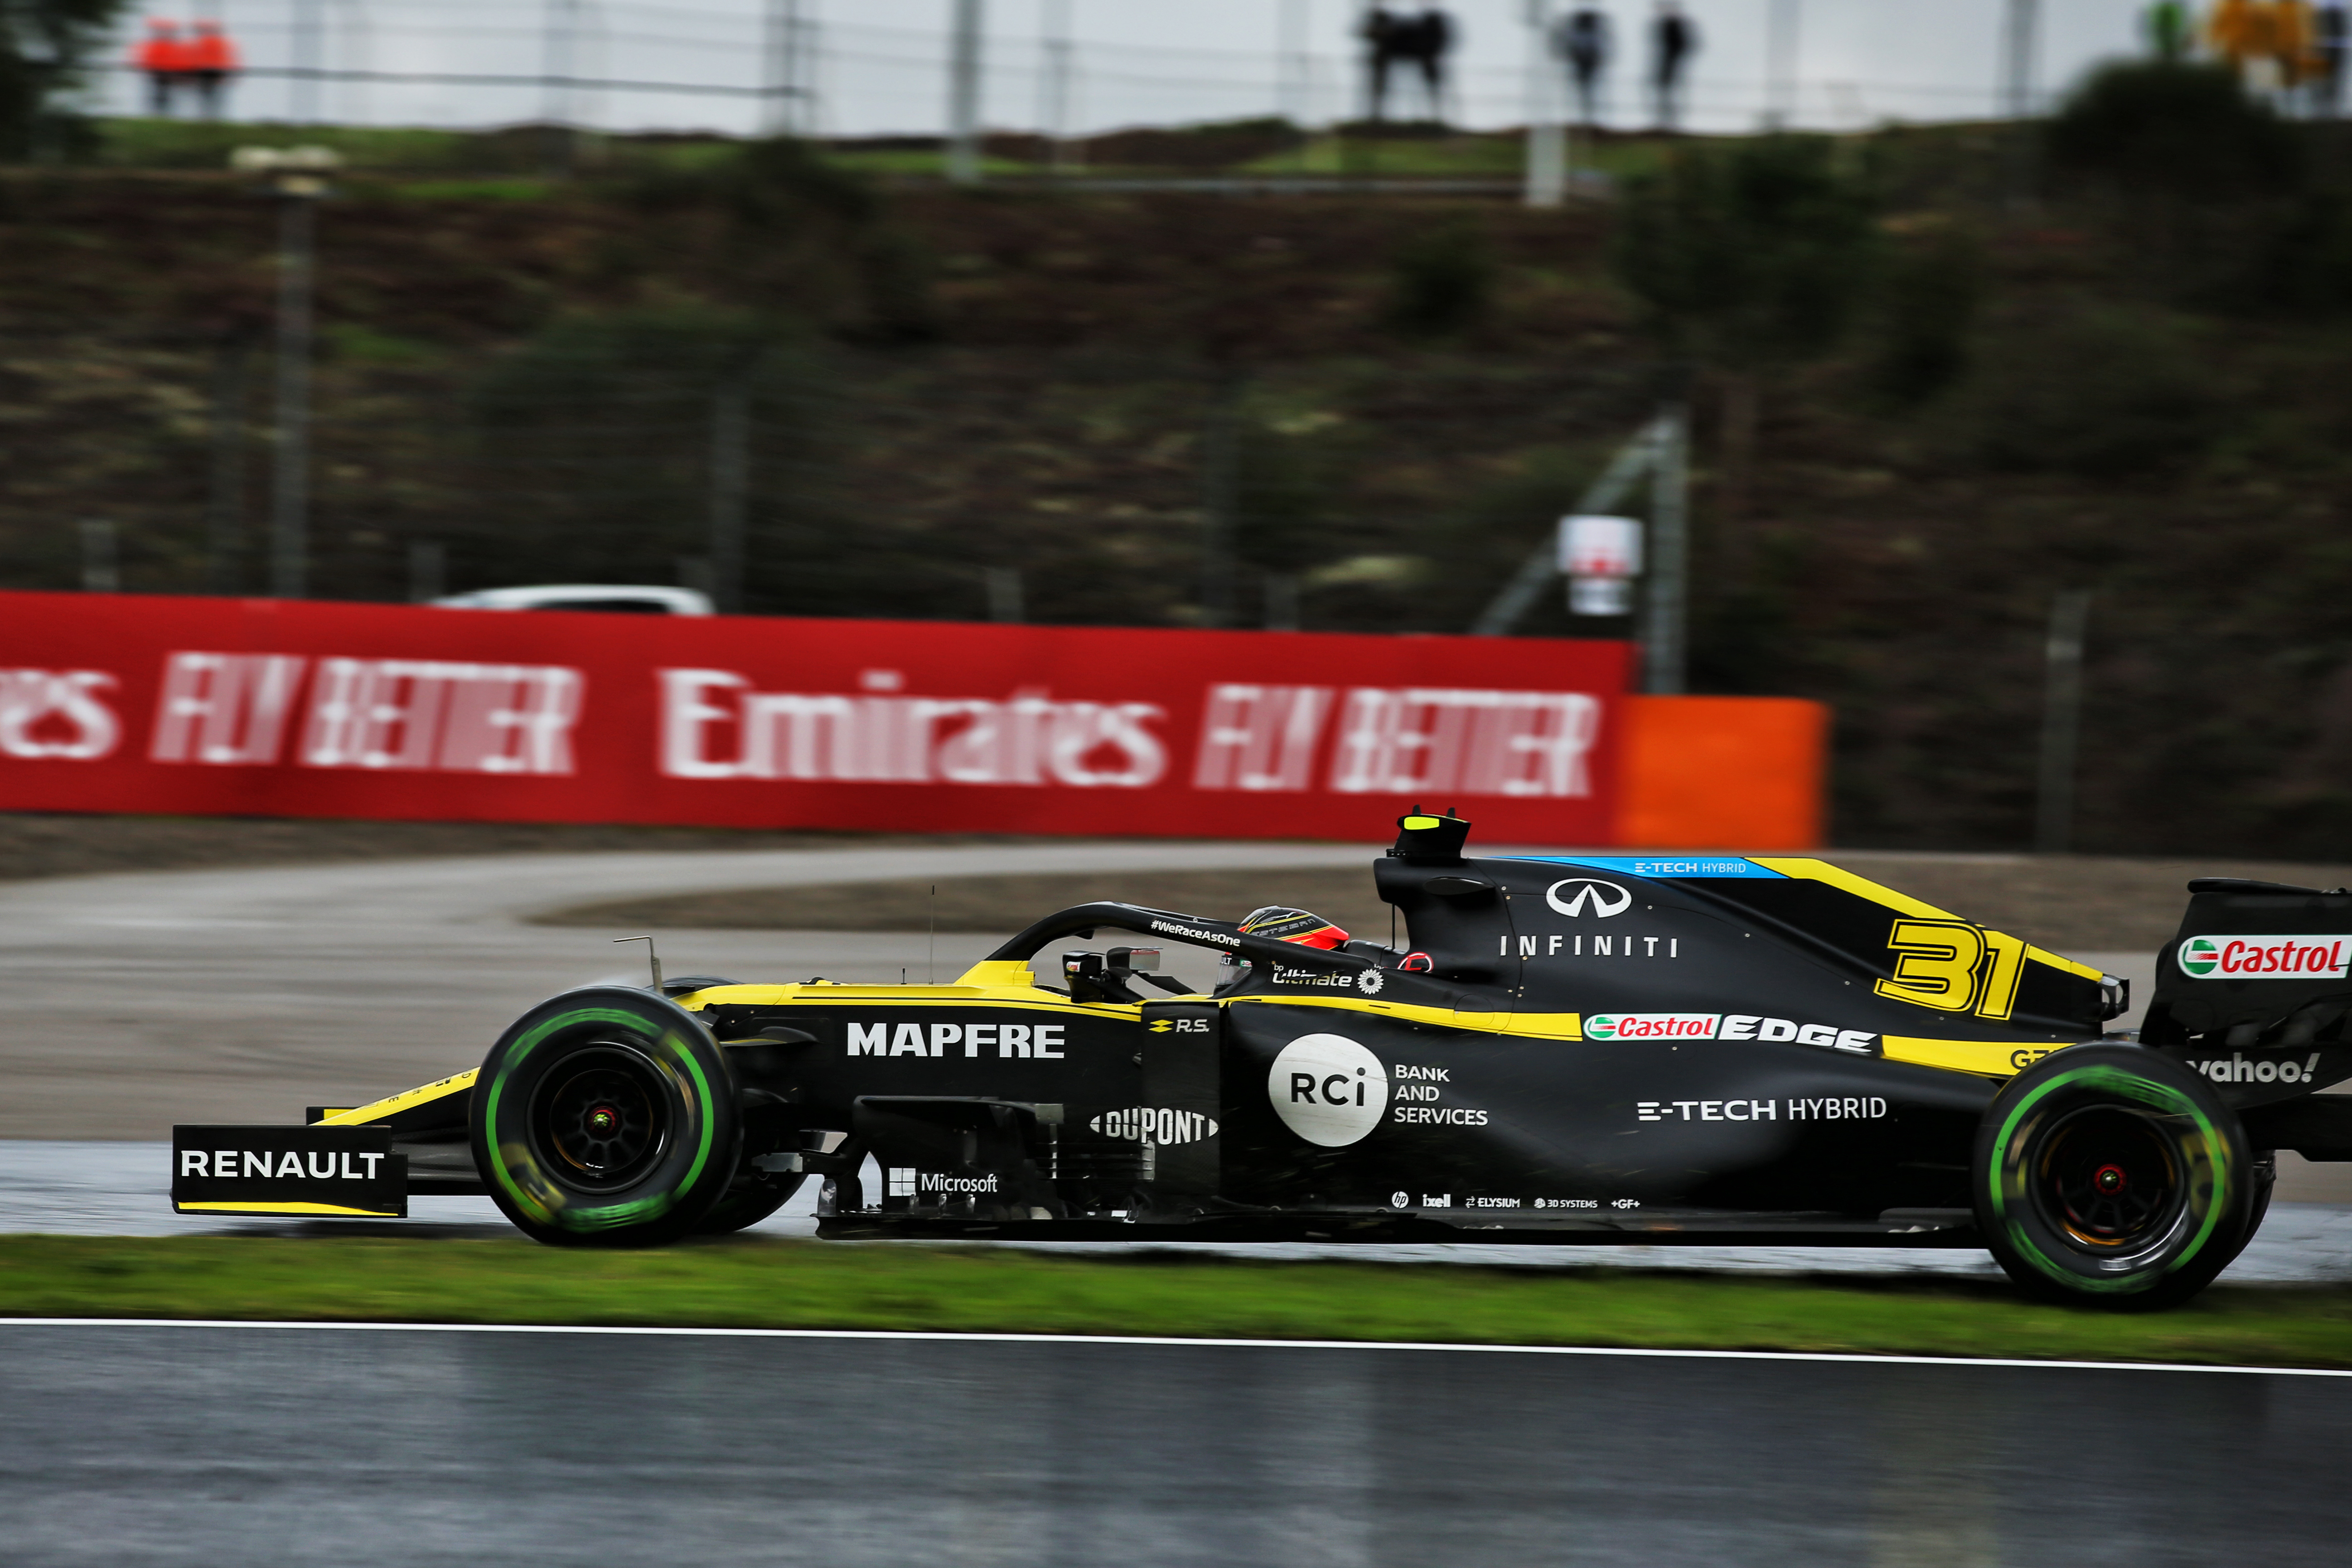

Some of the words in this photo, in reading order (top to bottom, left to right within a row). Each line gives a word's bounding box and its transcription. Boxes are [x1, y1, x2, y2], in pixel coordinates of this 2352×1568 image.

[151, 651, 306, 766] FLY
[298, 656, 585, 775] BETTER
[657, 667, 1167, 788] Emirates
[1194, 683, 1333, 793] FLY
[1330, 686, 1601, 798] BETTER
[1635, 862, 1697, 872] E-TECH
[1702, 863, 1746, 873] HYBRID
[1151, 919, 1240, 947] #WeRaceAsOne
[1500, 935, 1677, 958] INFINITI
[2221, 941, 2342, 973] Castrol
[1873, 919, 2030, 1020] 31
[1176, 1019, 1210, 1033] R.S.
[1618, 1017, 1713, 1037] Castrol
[1718, 1014, 1877, 1053] EDGE
[848, 1023, 1065, 1058] MAPFRE
[1395, 1064, 1450, 1082] BANK
[2186, 1052, 2321, 1083] yahoo!
[1395, 1085, 1440, 1101] AND
[1395, 1107, 1488, 1126] SERVICES
[1637, 1100, 1776, 1121] E-TECH
[1788, 1098, 1886, 1120] HYBRID
[1106, 1107, 1205, 1145] DUPONT
[181, 1150, 385, 1180] RENAULT
[921, 1173, 998, 1193] Microsoft
[1392, 1191, 1408, 1208] hp
[1422, 1194, 1451, 1208] ixell
[1477, 1197, 1520, 1208] ELYSIUM
[1547, 1199, 1558, 1208] 3D
[1560, 1200, 1598, 1208] SYSTEMS
